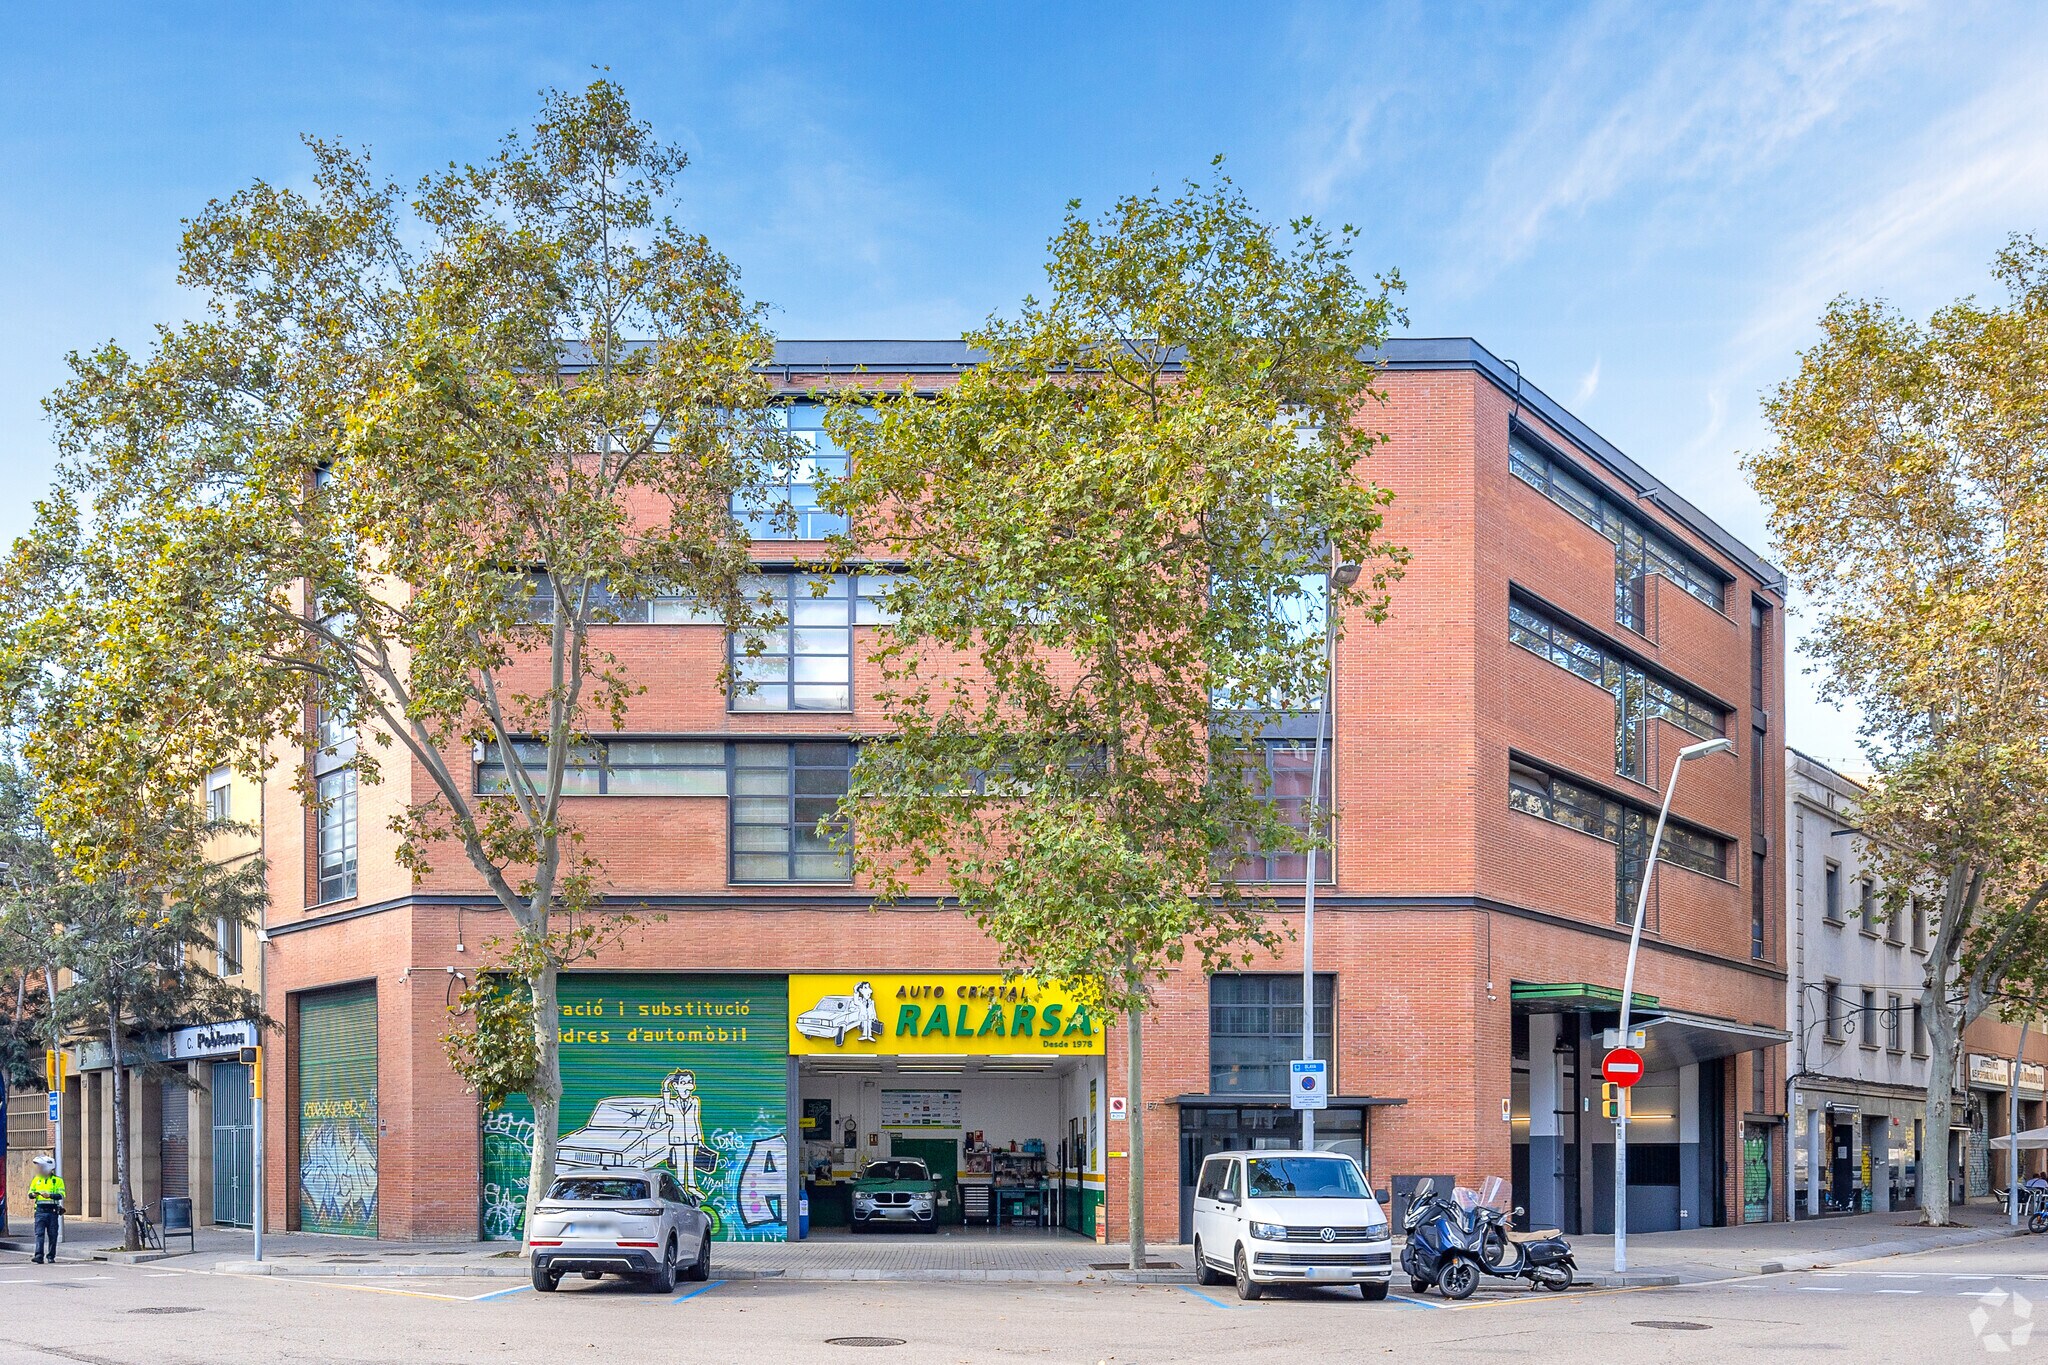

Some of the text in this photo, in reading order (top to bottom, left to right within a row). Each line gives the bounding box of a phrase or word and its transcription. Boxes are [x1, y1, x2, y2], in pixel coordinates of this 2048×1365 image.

[896, 985, 1027, 999] AUTO CRISTAL
[557, 998, 750, 1016] ació i substitució
[896, 1004, 1092, 1037] RALARSA
[197, 1031, 245, 1049] Poblenou
[557, 1024, 747, 1043] idres d'automòbil
[1043, 1040, 1093, 1048] Desde 1978
